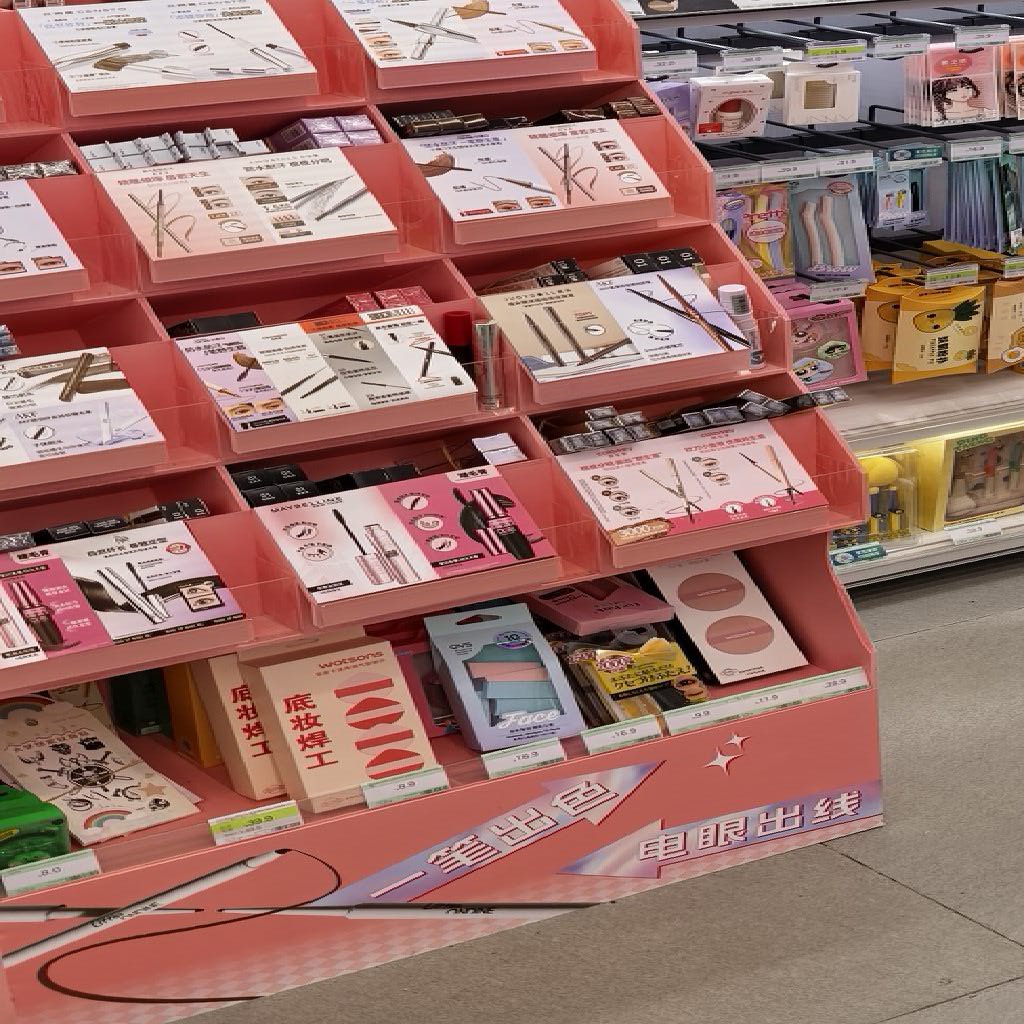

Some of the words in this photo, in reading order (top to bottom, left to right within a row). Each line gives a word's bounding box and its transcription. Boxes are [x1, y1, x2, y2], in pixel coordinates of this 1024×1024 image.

[318, 651, 385, 669] watsons
[282, 692, 339, 770] 底妆焊工
[638, 789, 863, 863] 电眼出线
